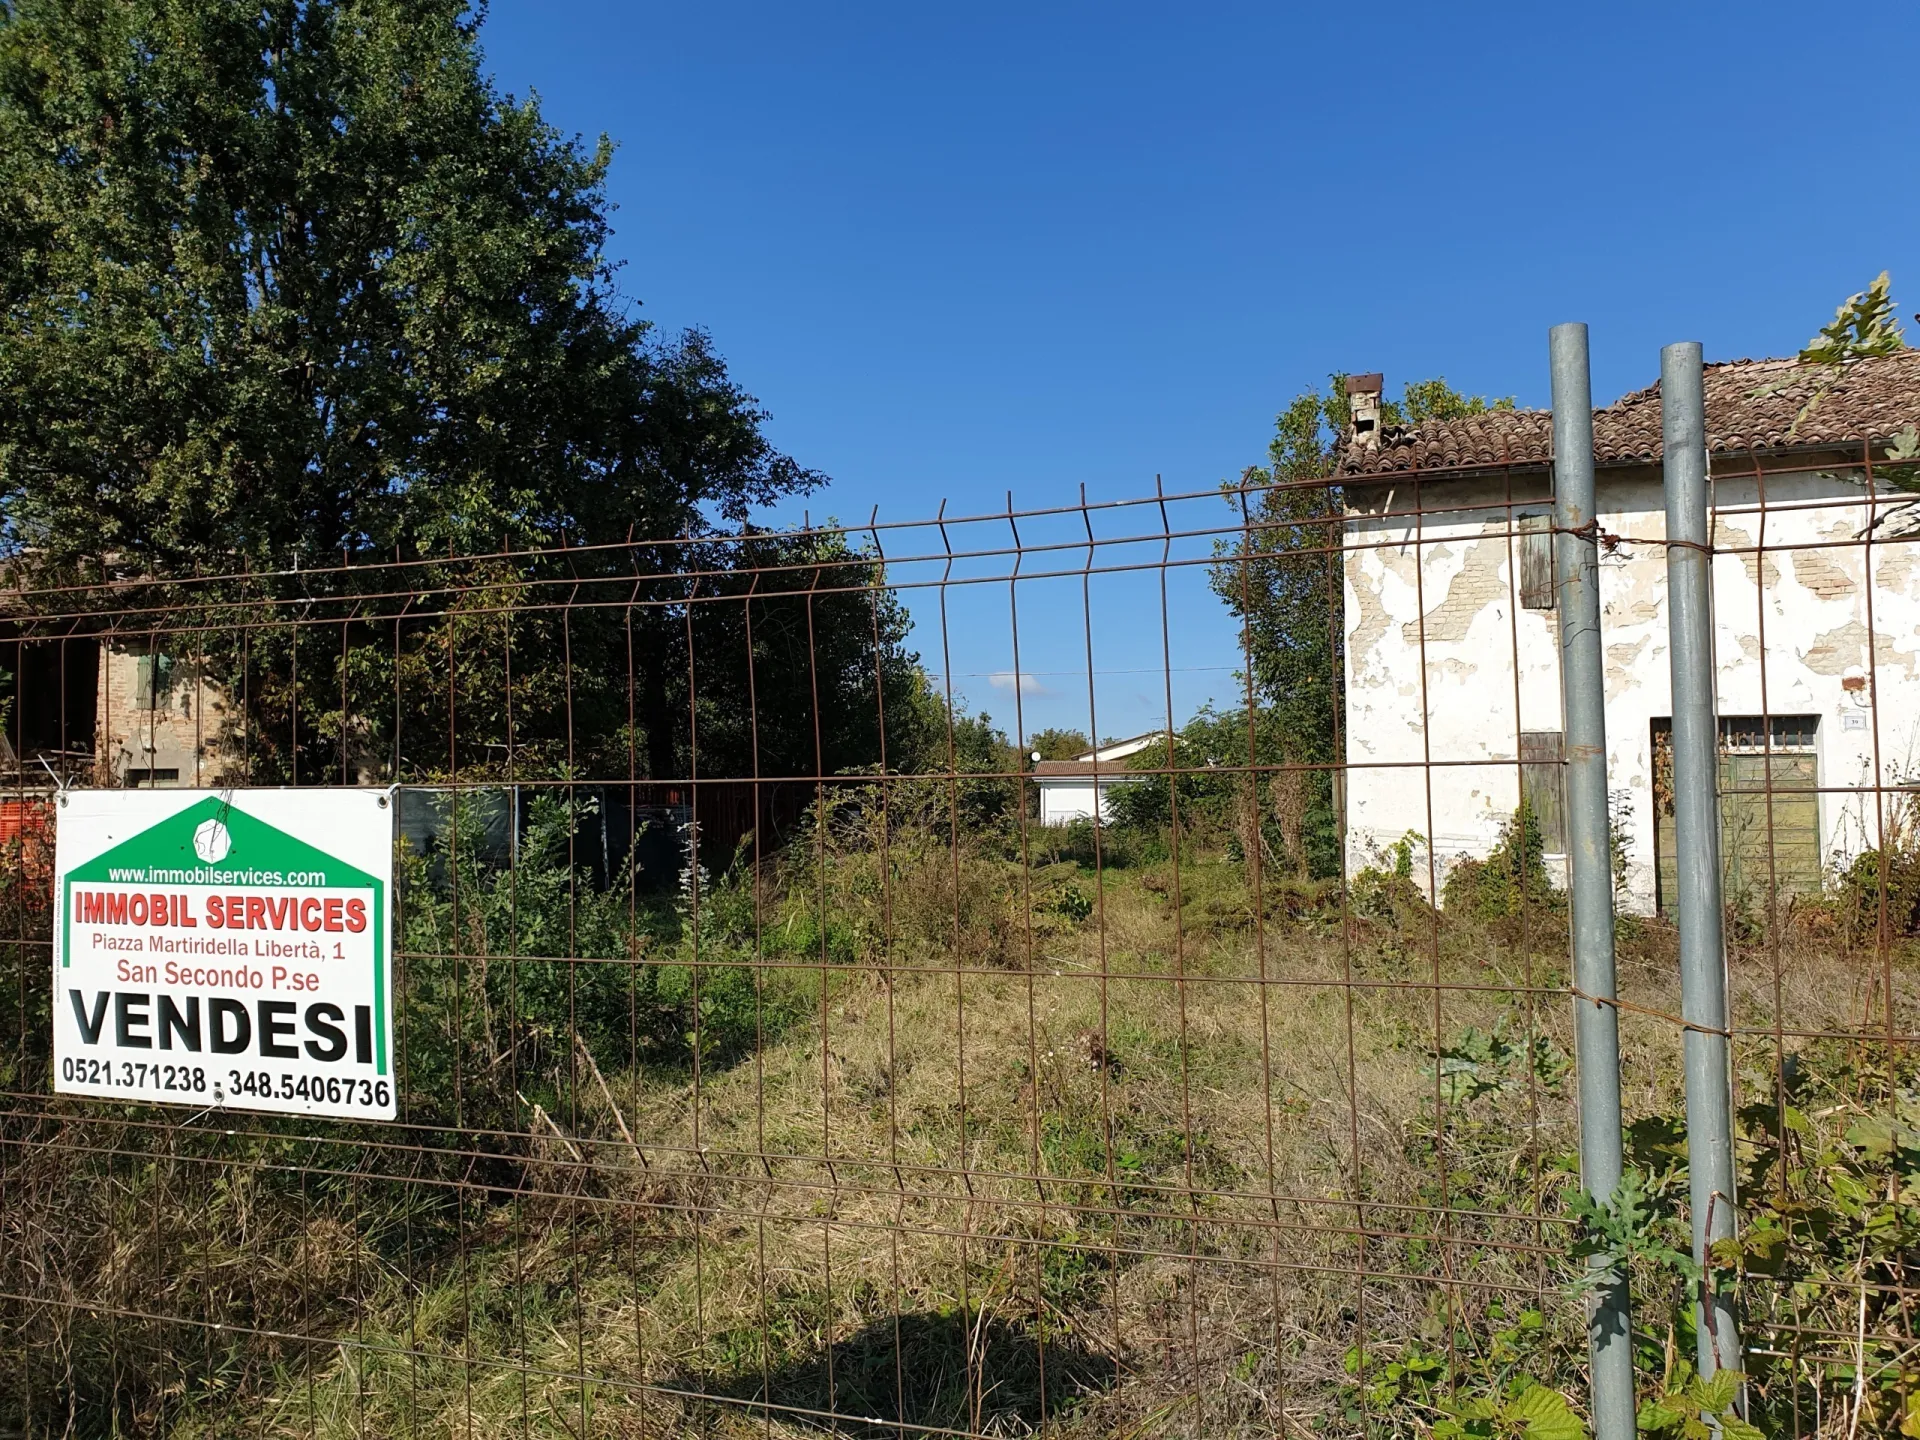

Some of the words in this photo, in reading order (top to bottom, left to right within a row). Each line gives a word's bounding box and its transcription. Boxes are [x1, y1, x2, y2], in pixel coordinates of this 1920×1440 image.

[108, 865, 326, 886] www.immobilservices.com
[75, 891, 198, 928] IMMOBIL
[205, 895, 367, 933] SERVICES
[92, 932, 143, 952] Piazza
[149, 935, 248, 956] Martiridella
[255, 939, 326, 962] Libertà,
[332, 942, 346, 960] 1
[117, 958, 158, 984] San
[164, 961, 264, 990] Secondo
[272, 965, 320, 992] P.se
[68, 989, 373, 1064] VENDESI
[62, 1057, 207, 1092] 0521.371238
[228, 1069, 391, 1107] 348.5406736
